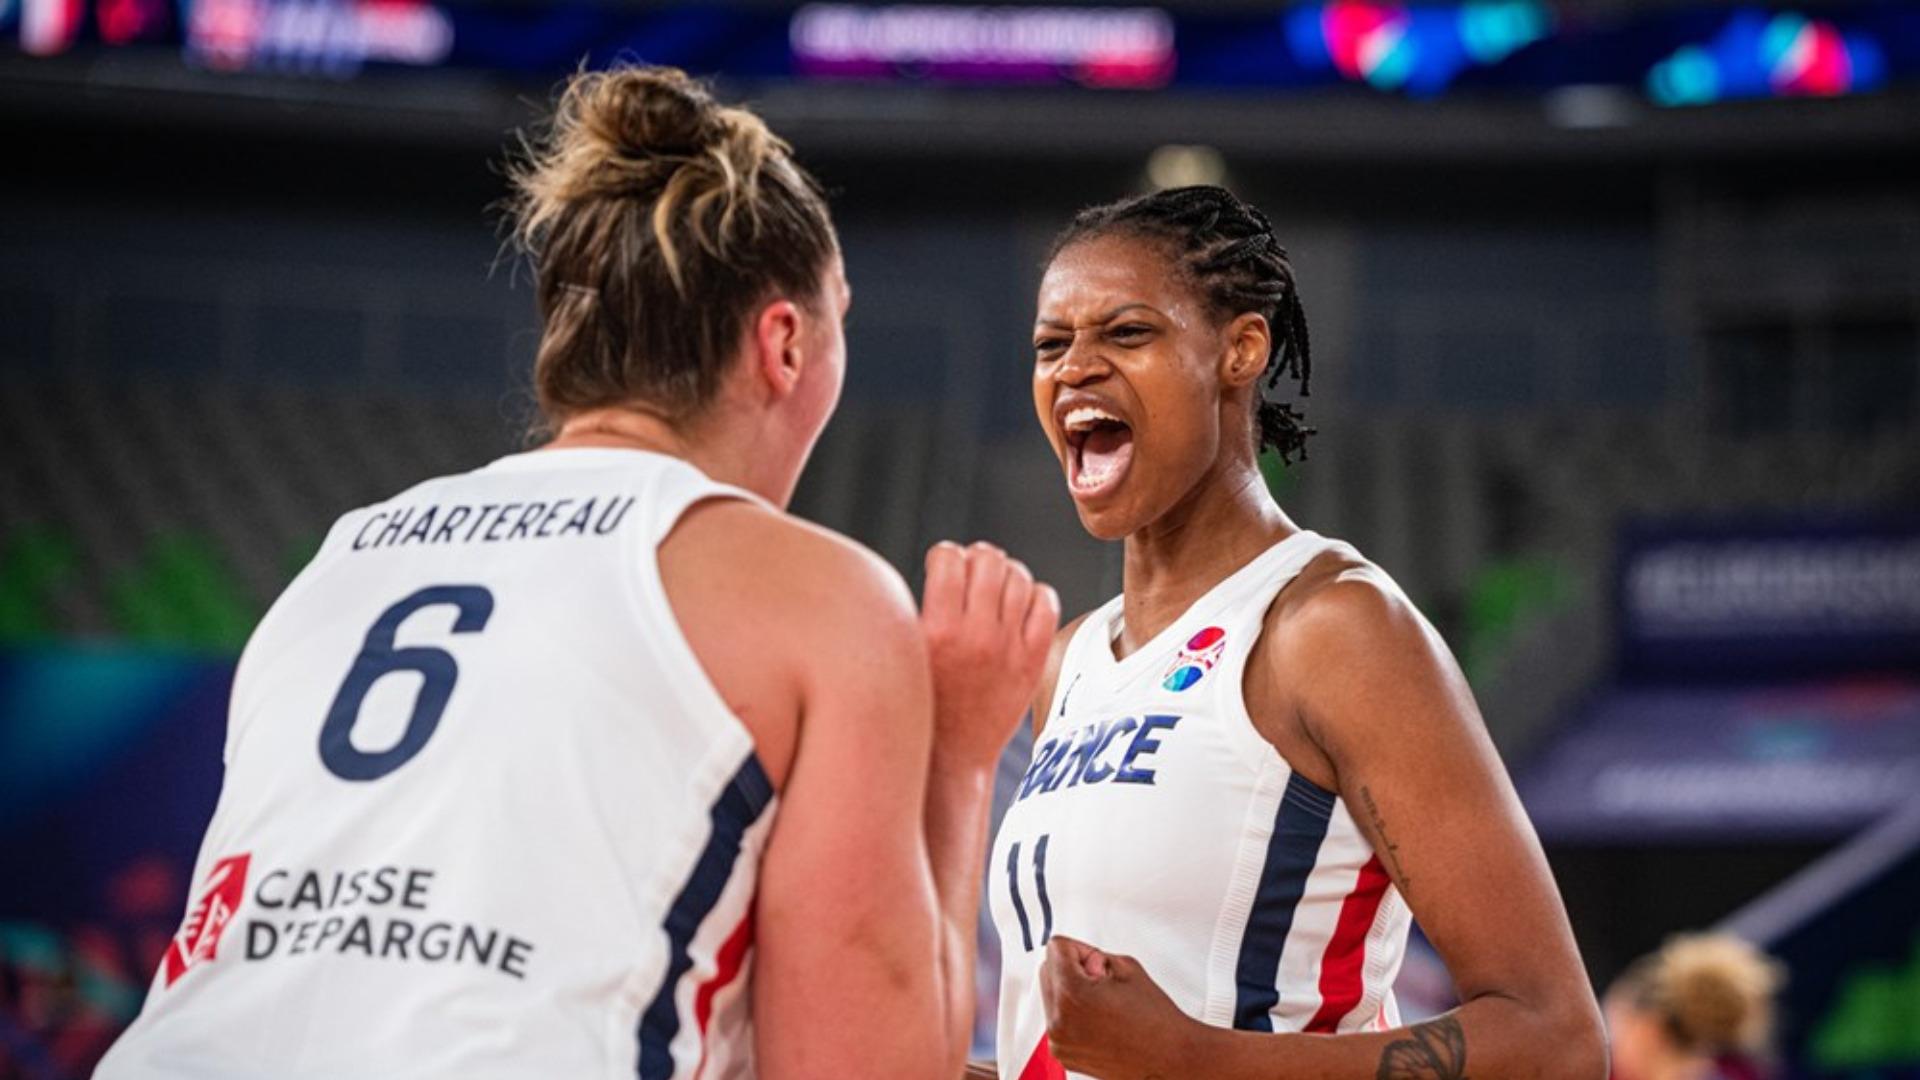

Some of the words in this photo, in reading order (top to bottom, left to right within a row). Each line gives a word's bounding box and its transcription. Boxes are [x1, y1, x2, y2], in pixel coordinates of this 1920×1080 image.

[352, 497, 635, 552] CHARTEREAU
[318, 584, 495, 783] 6
[1018, 715, 1182, 801] RANCE
[254, 867, 435, 911] CAISSE
[1007, 833, 1053, 952] 11
[244, 915, 534, 979] D'EPARGNE
